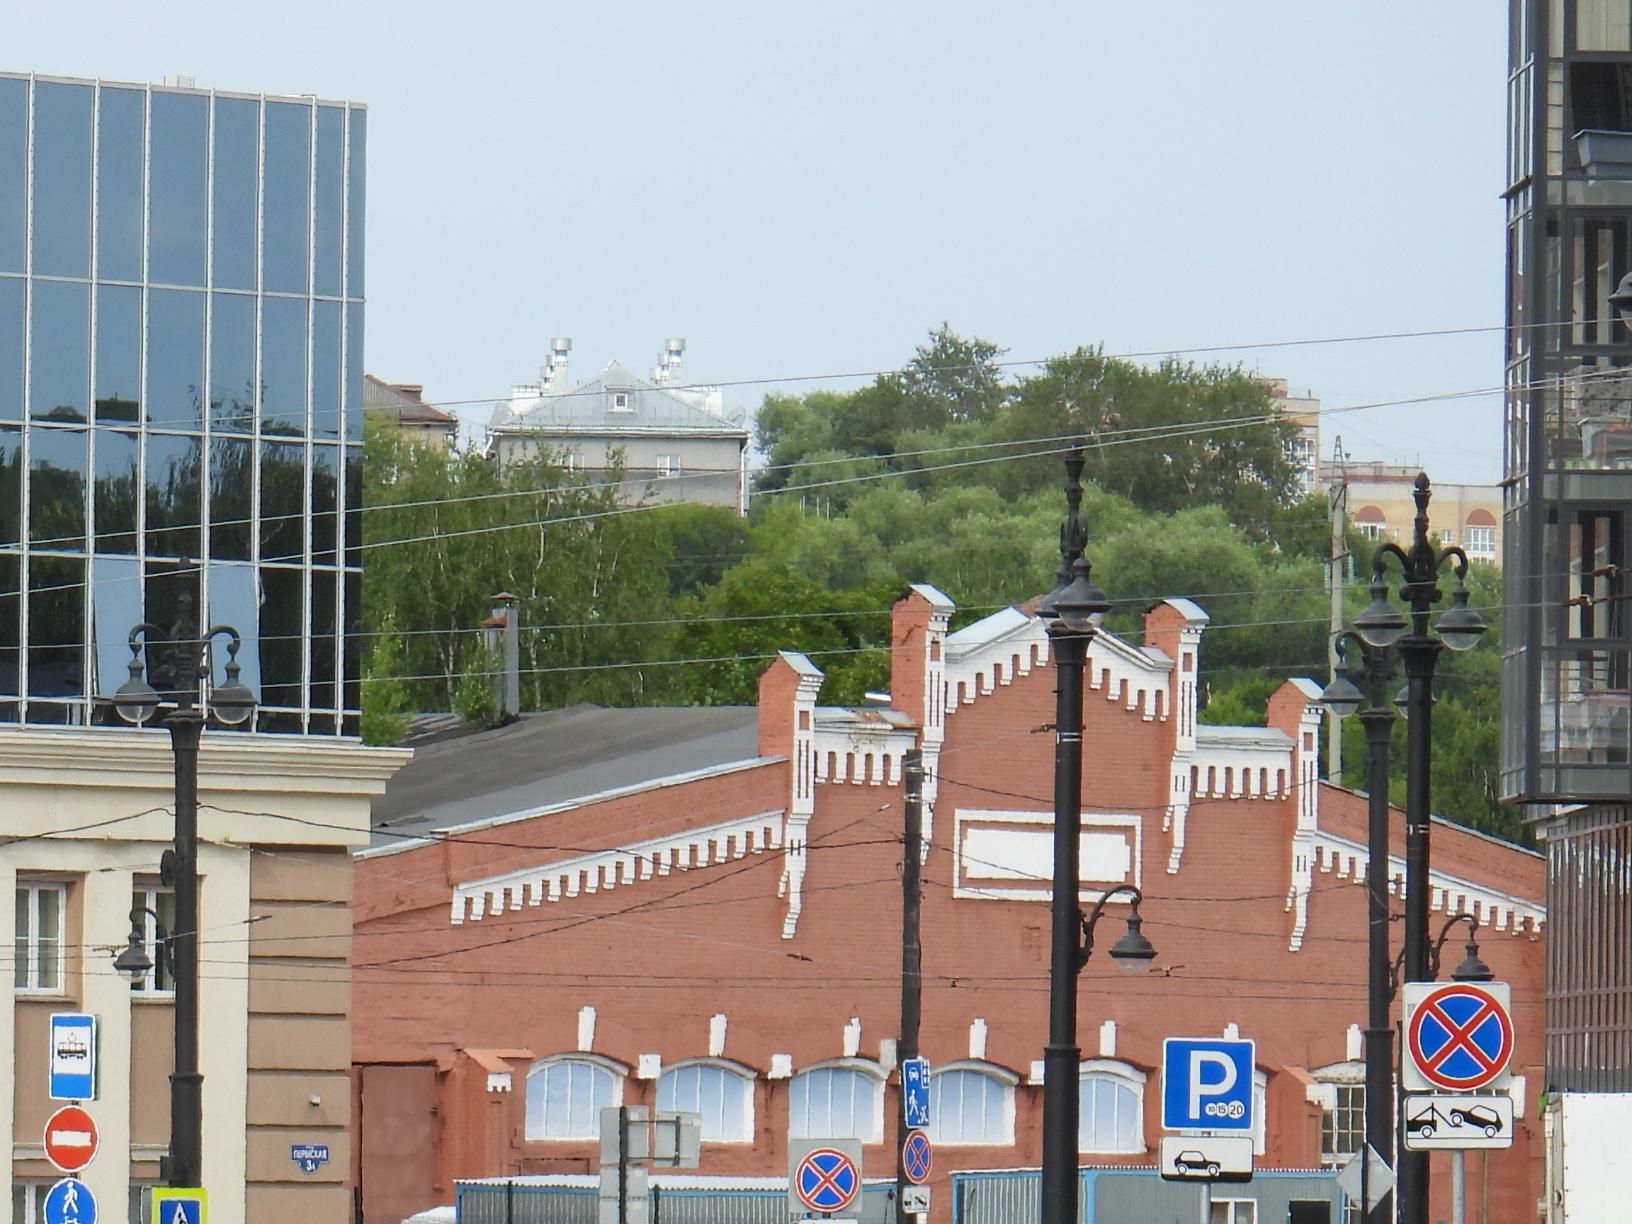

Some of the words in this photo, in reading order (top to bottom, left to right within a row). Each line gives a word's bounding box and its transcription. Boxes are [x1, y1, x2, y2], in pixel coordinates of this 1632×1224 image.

[1189, 1050, 1238, 1120] P
[1217, 1105, 1226, 1114] 15
[1229, 1105, 1243, 1115] 20
